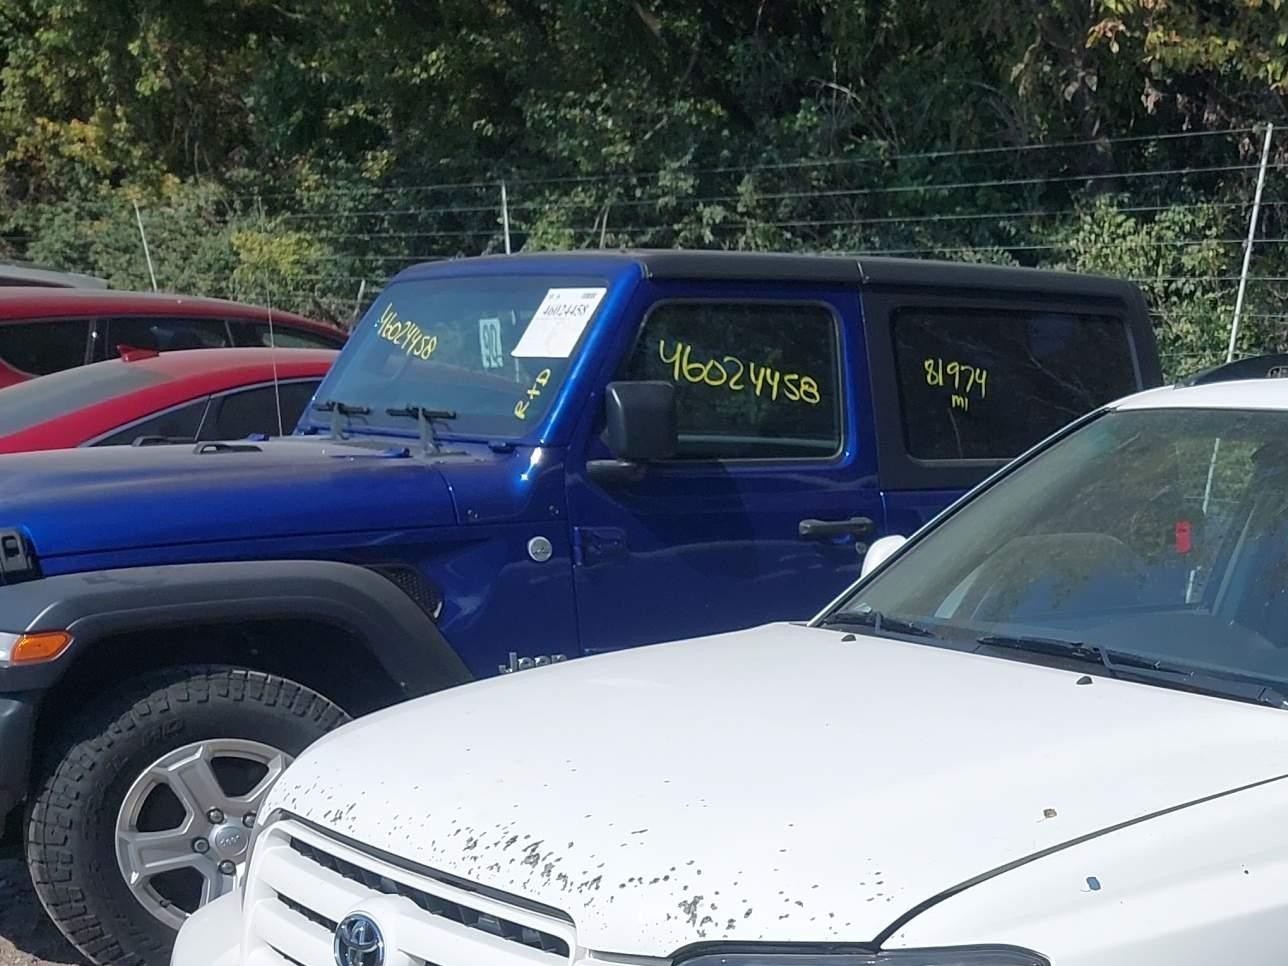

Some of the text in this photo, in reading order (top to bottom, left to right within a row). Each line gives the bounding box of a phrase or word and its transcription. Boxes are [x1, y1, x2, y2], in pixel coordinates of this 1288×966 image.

[377, 302, 438, 361] 46024458
[658, 338, 821, 405] 46024458
[923, 357, 988, 399] 81974
